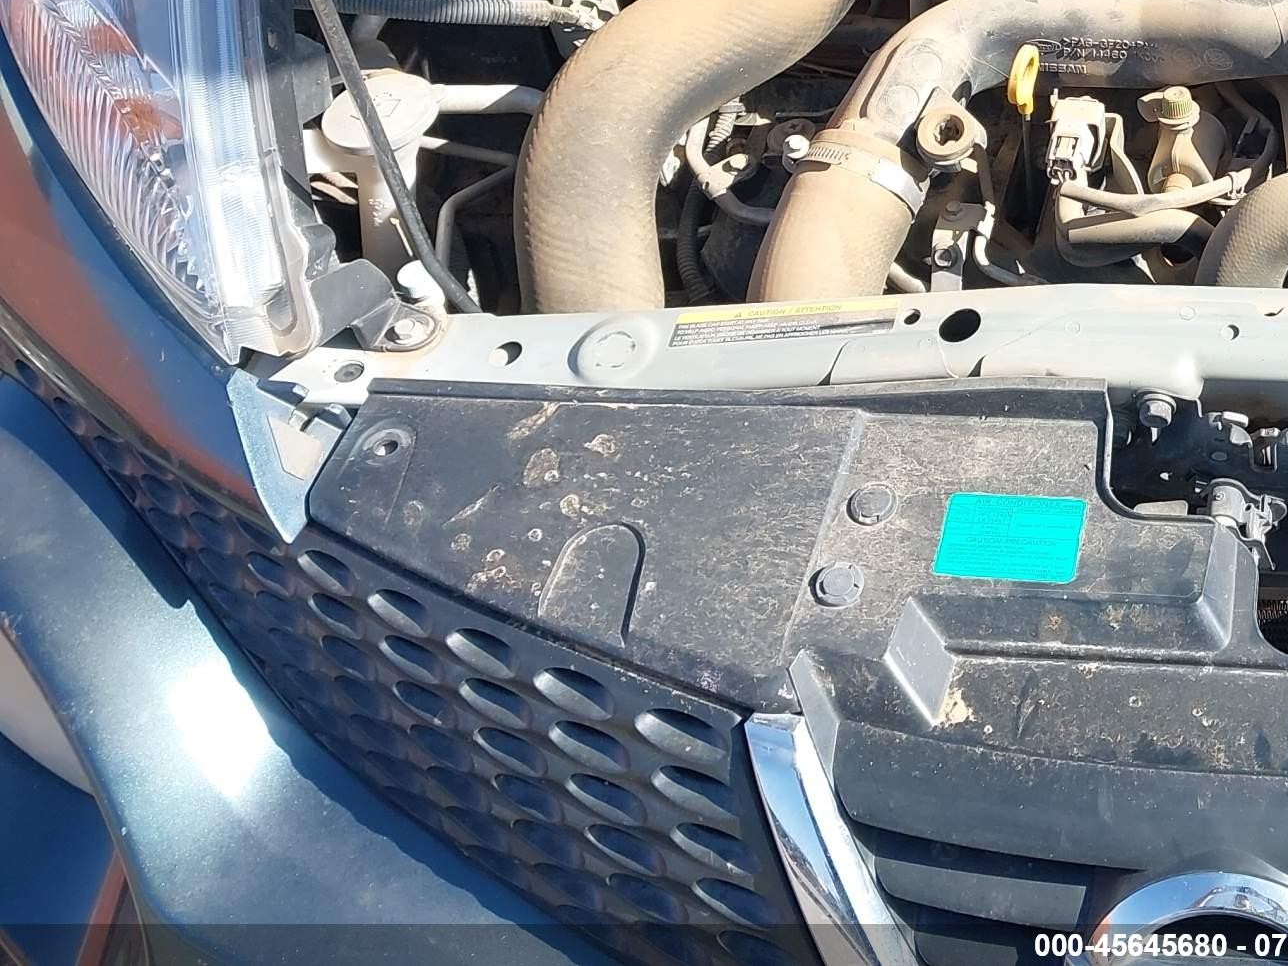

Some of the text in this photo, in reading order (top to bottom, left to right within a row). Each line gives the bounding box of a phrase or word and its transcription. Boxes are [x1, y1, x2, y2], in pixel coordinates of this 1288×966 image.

[749, 309, 785, 317] CAUTION
[976, 498, 993, 506] AIR
[996, 498, 1062, 508] CONDITIONER
[966, 537, 1057, 547] CAUTION PRECAUTION
